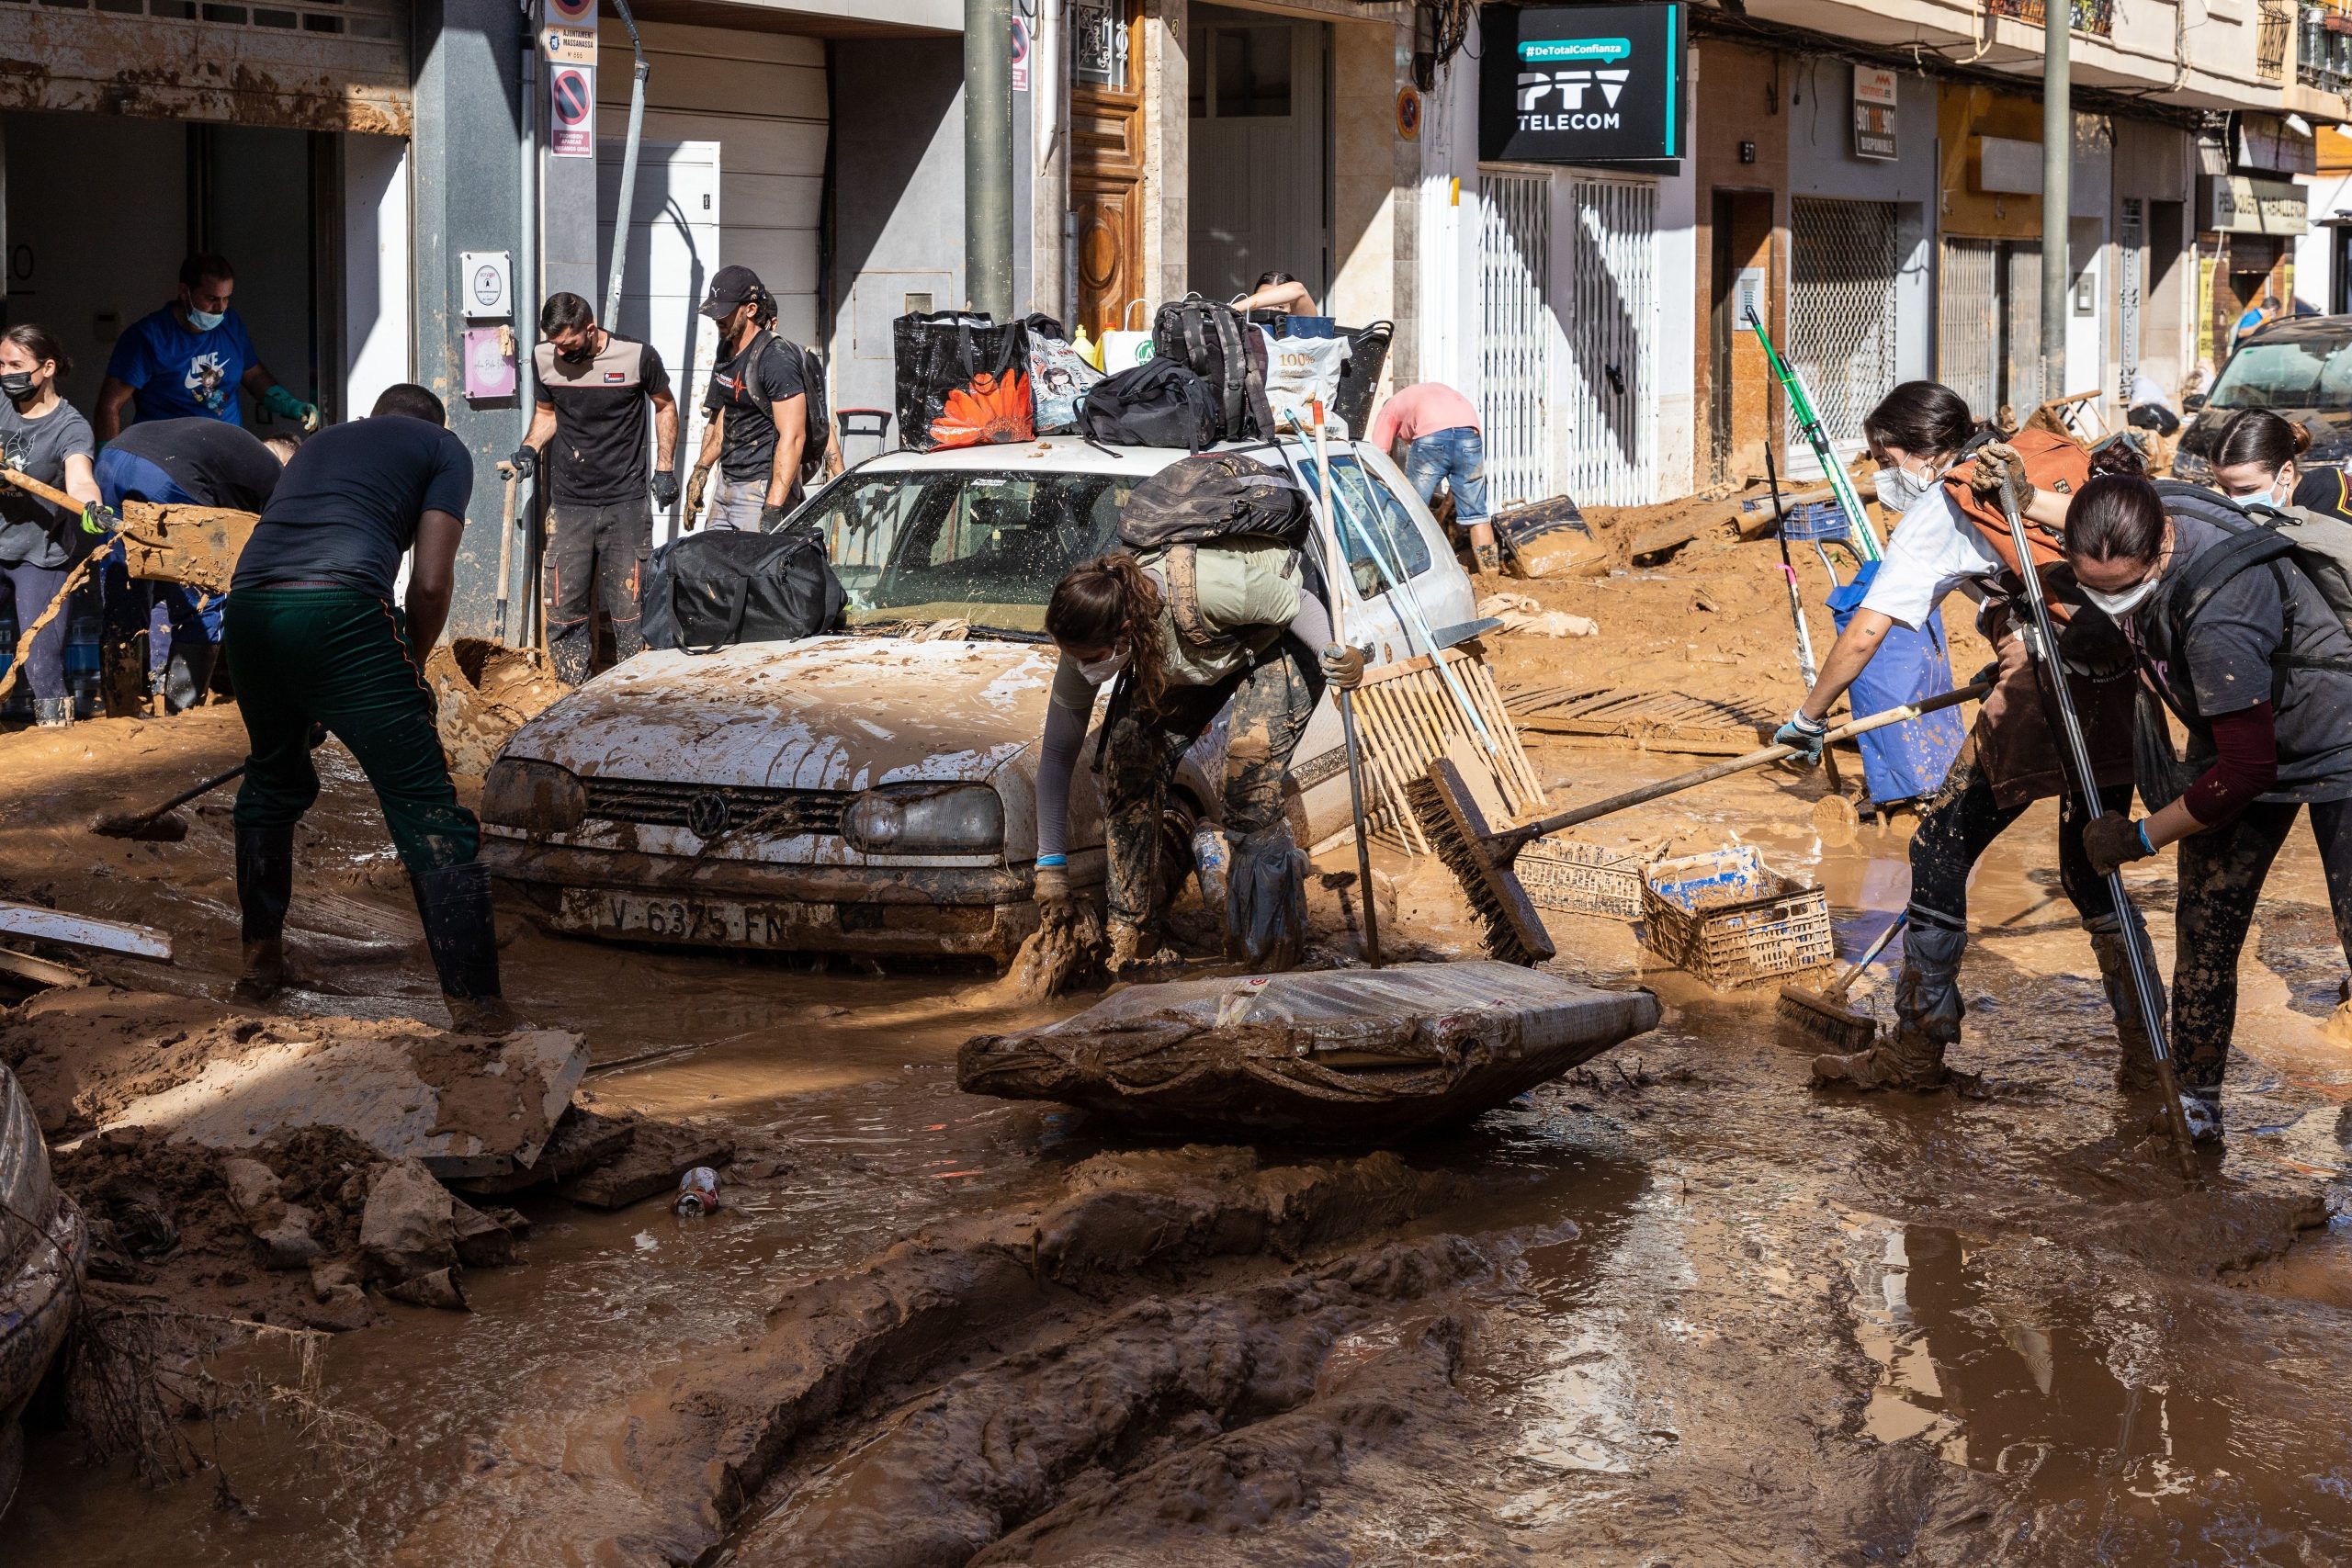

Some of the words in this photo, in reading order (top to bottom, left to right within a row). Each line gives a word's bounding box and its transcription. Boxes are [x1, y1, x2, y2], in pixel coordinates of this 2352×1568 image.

[562, 28, 594, 39] AJUNTAMENT
[562, 39, 594, 49] MASSANASSA
[1525, 44, 1623, 57] #DeTotalConfianza
[1517, 69, 1631, 111] PTV
[1517, 112, 1620, 131] TELECOM
[1860, 136, 1894, 154] DISPONIBLE
[191, 351, 219, 375] NIKE
[1278, 352, 1316, 367] 100%
